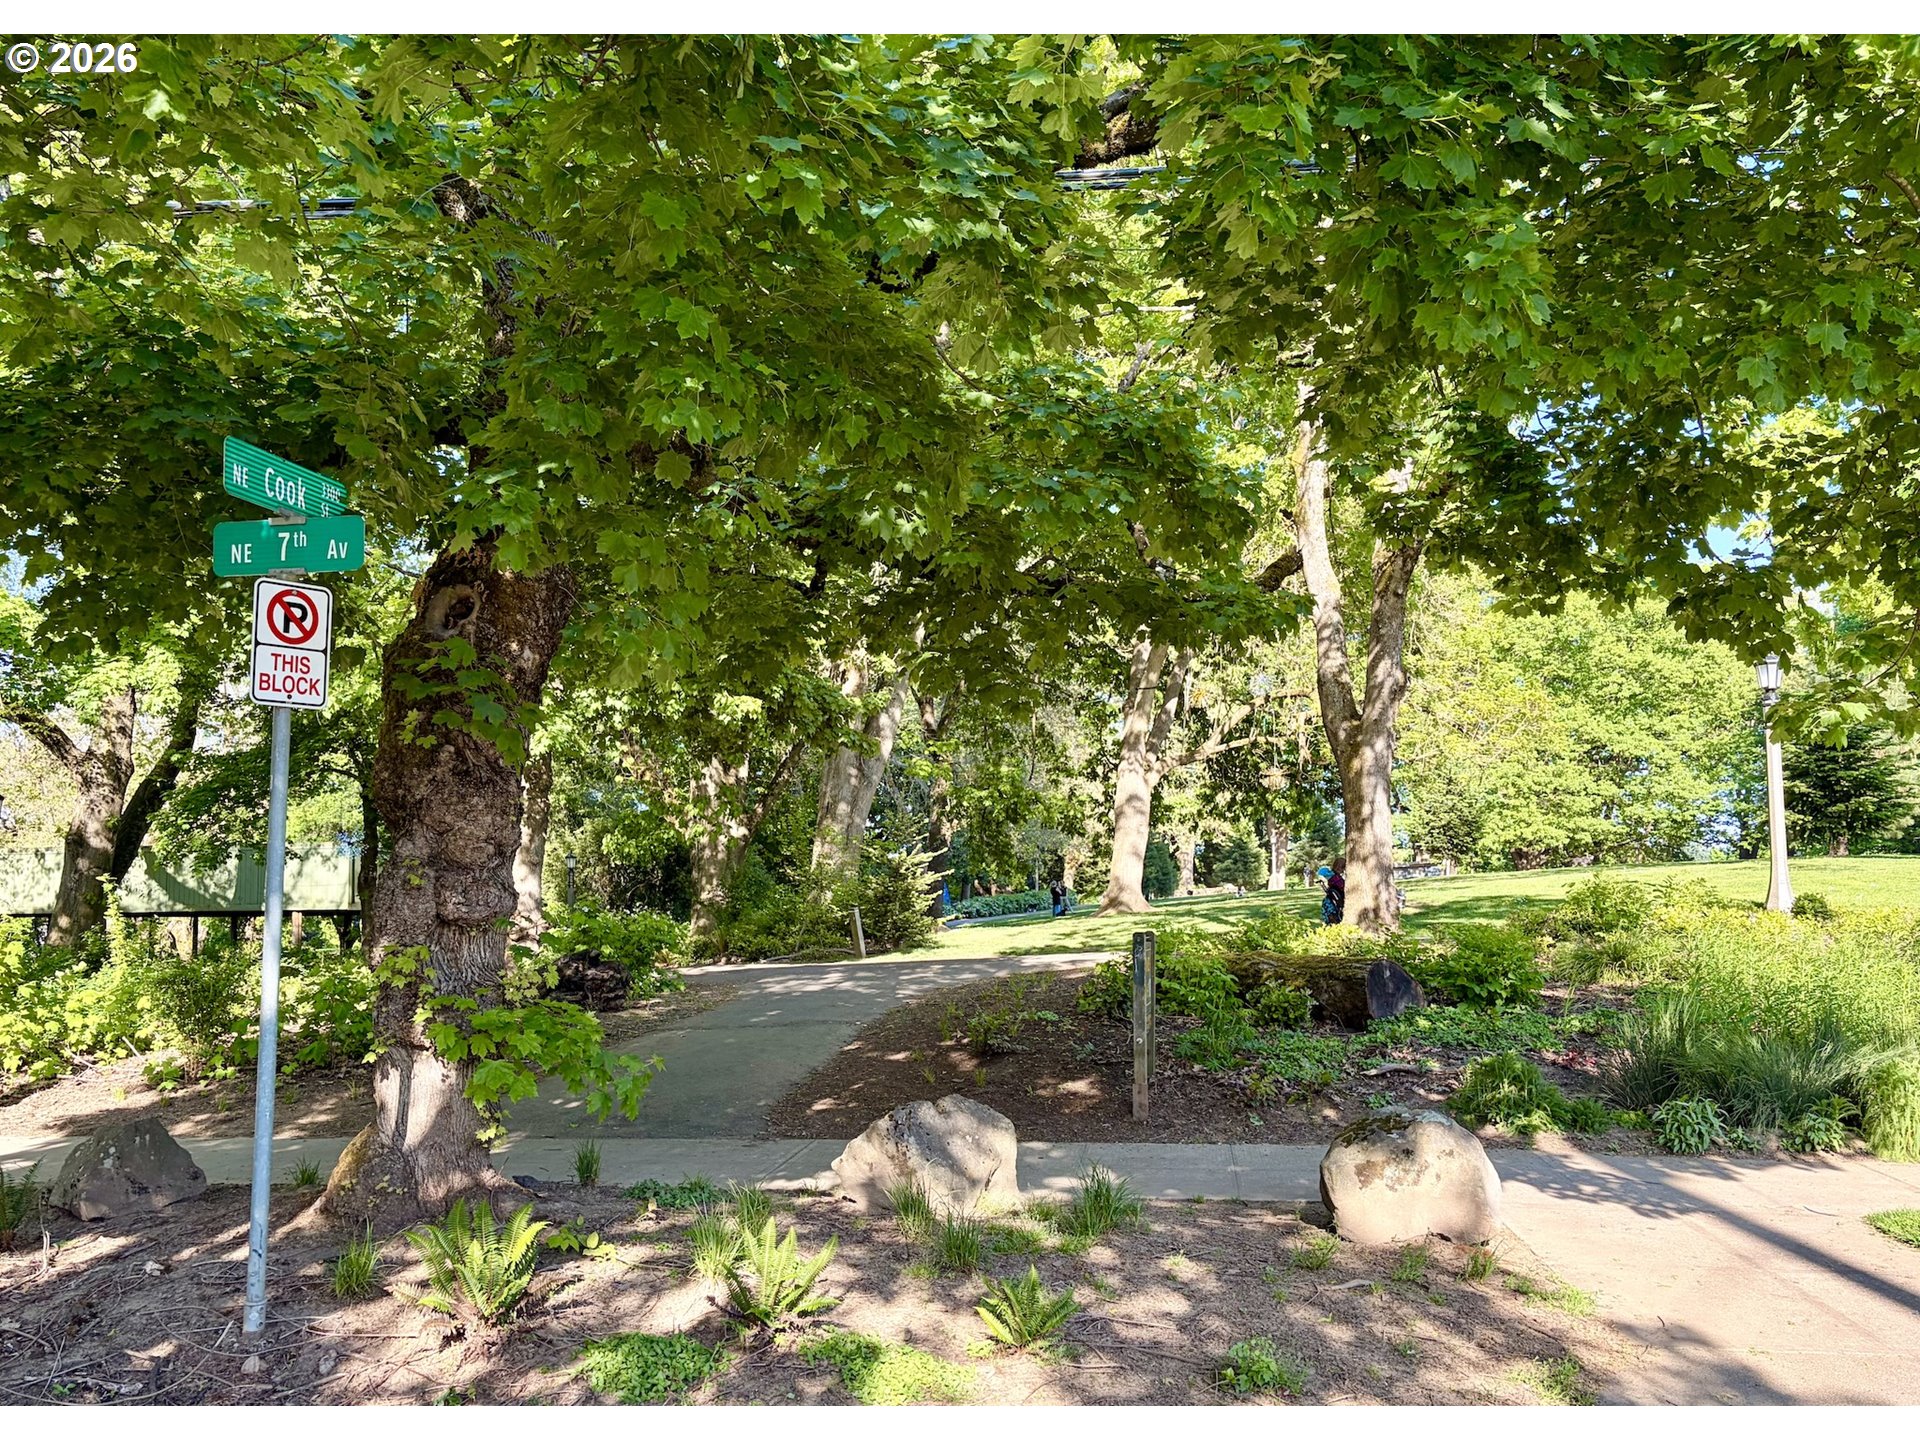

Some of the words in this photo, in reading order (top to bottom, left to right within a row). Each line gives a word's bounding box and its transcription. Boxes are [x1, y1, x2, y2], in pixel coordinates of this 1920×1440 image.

[233, 463, 249, 488] NE
[265, 467, 306, 510] Cook
[231, 543, 252, 564] NE
[278, 530, 307, 561] 7th
[327, 539, 348, 559] Av
[271, 652, 311, 675] THIS
[259, 672, 321, 697] BLOCK
